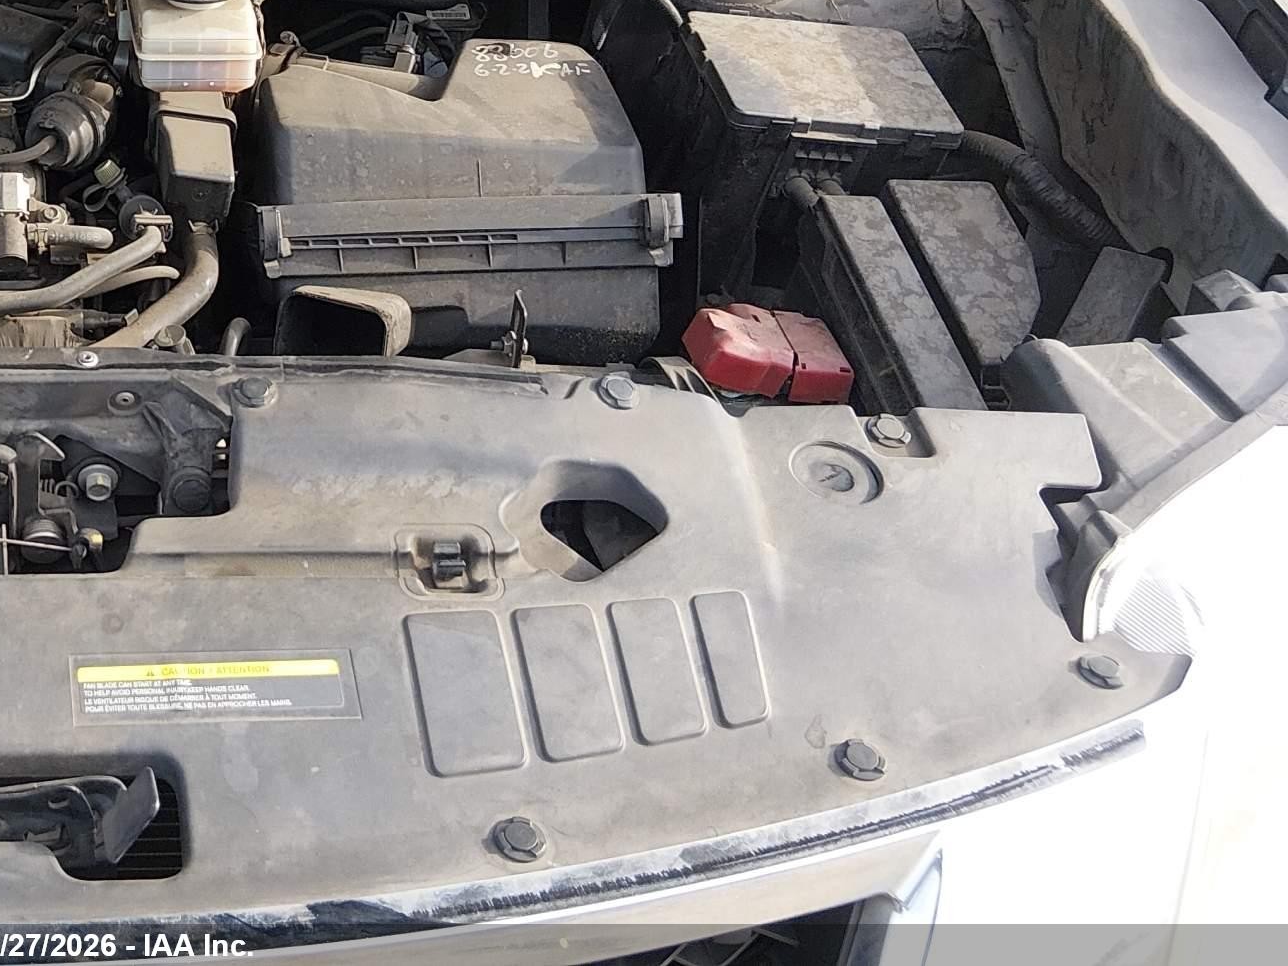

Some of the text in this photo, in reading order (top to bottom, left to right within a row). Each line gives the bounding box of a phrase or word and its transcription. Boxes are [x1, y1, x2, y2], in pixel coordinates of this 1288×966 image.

[205, 685, 227, 693] HANDS
[94, 697, 134, 705] VENTILATEUR
[85, 705, 104, 713] POUR
